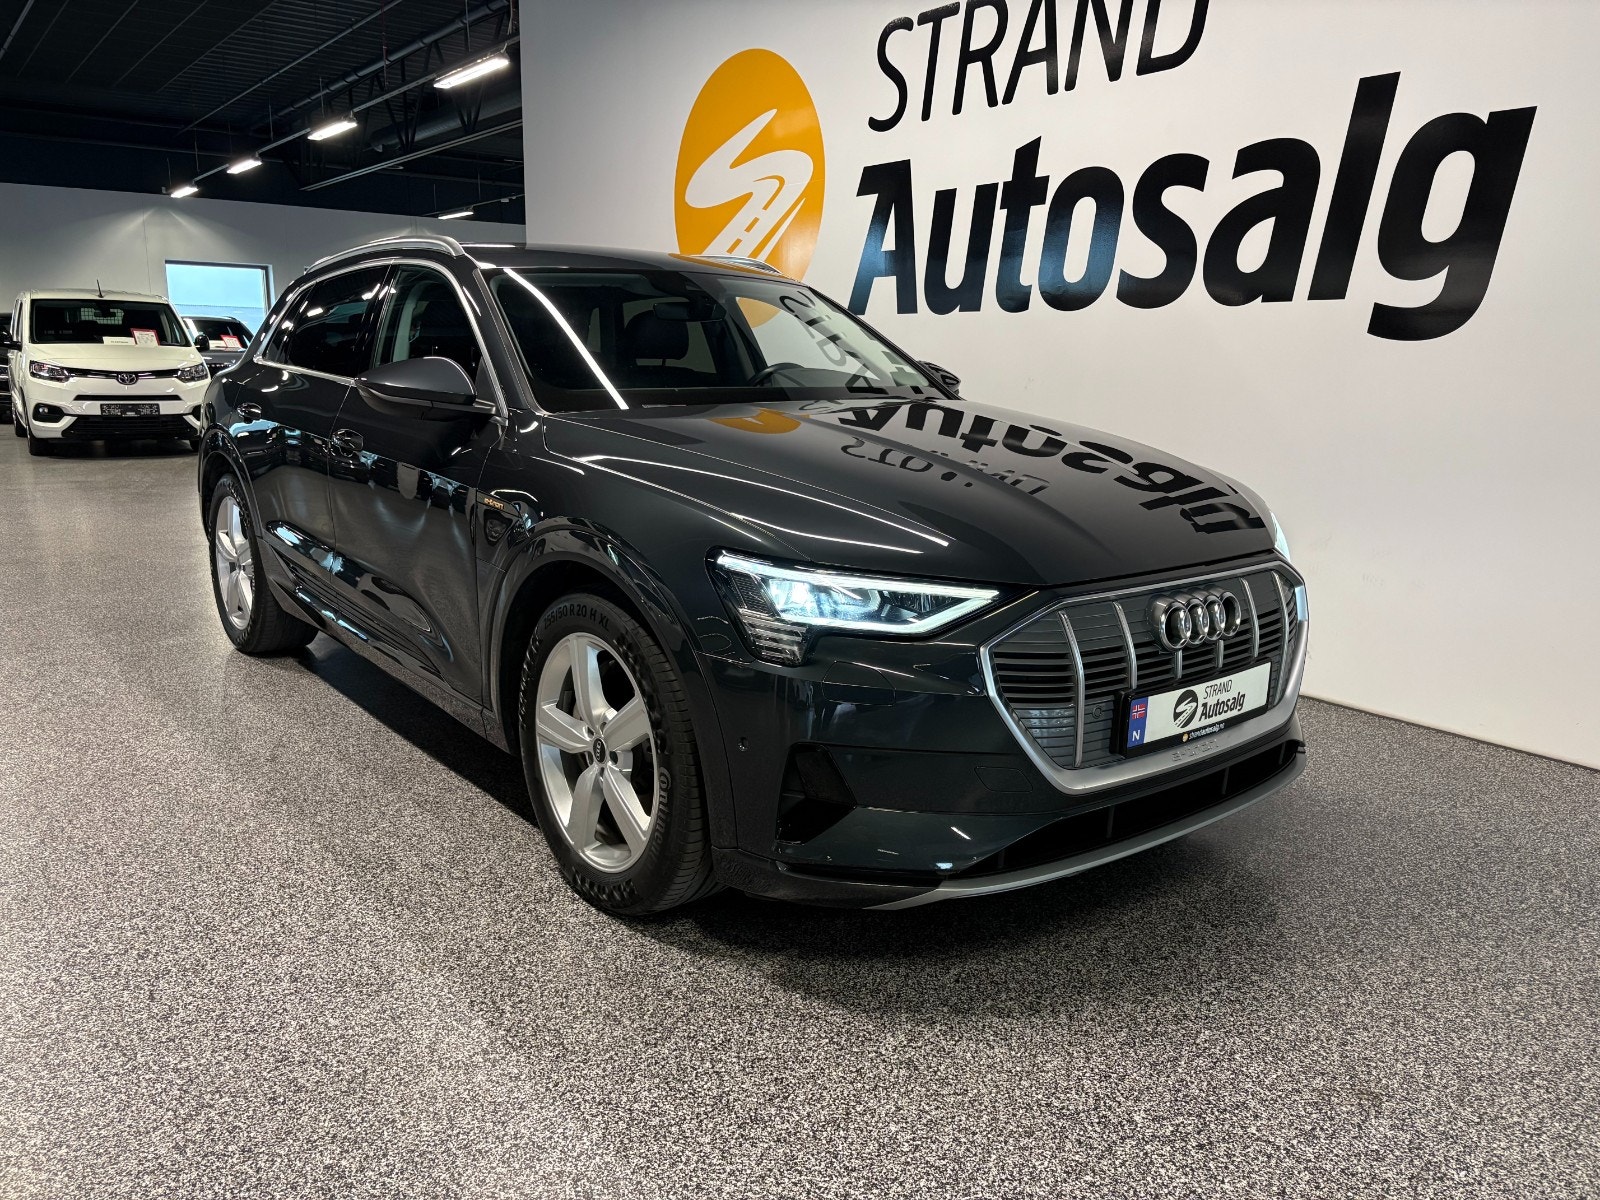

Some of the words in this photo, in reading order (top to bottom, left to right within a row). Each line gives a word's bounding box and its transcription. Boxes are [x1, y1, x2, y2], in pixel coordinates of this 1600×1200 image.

[868, 0, 1208, 132] STRAND
[848, 71, 1537, 341] Autosalg
[484, 498, 505, 510] e-tron
[570, 604, 575, 616] R
[577, 604, 587, 617] 20
[590, 608, 597, 621] H
[599, 612, 610, 632] XL
[1203, 680, 1233, 700] STRAND
[1199, 691, 1246, 721] Autosalg
[1132, 729, 1141, 742] N
[647, 766, 672, 872] Continent
